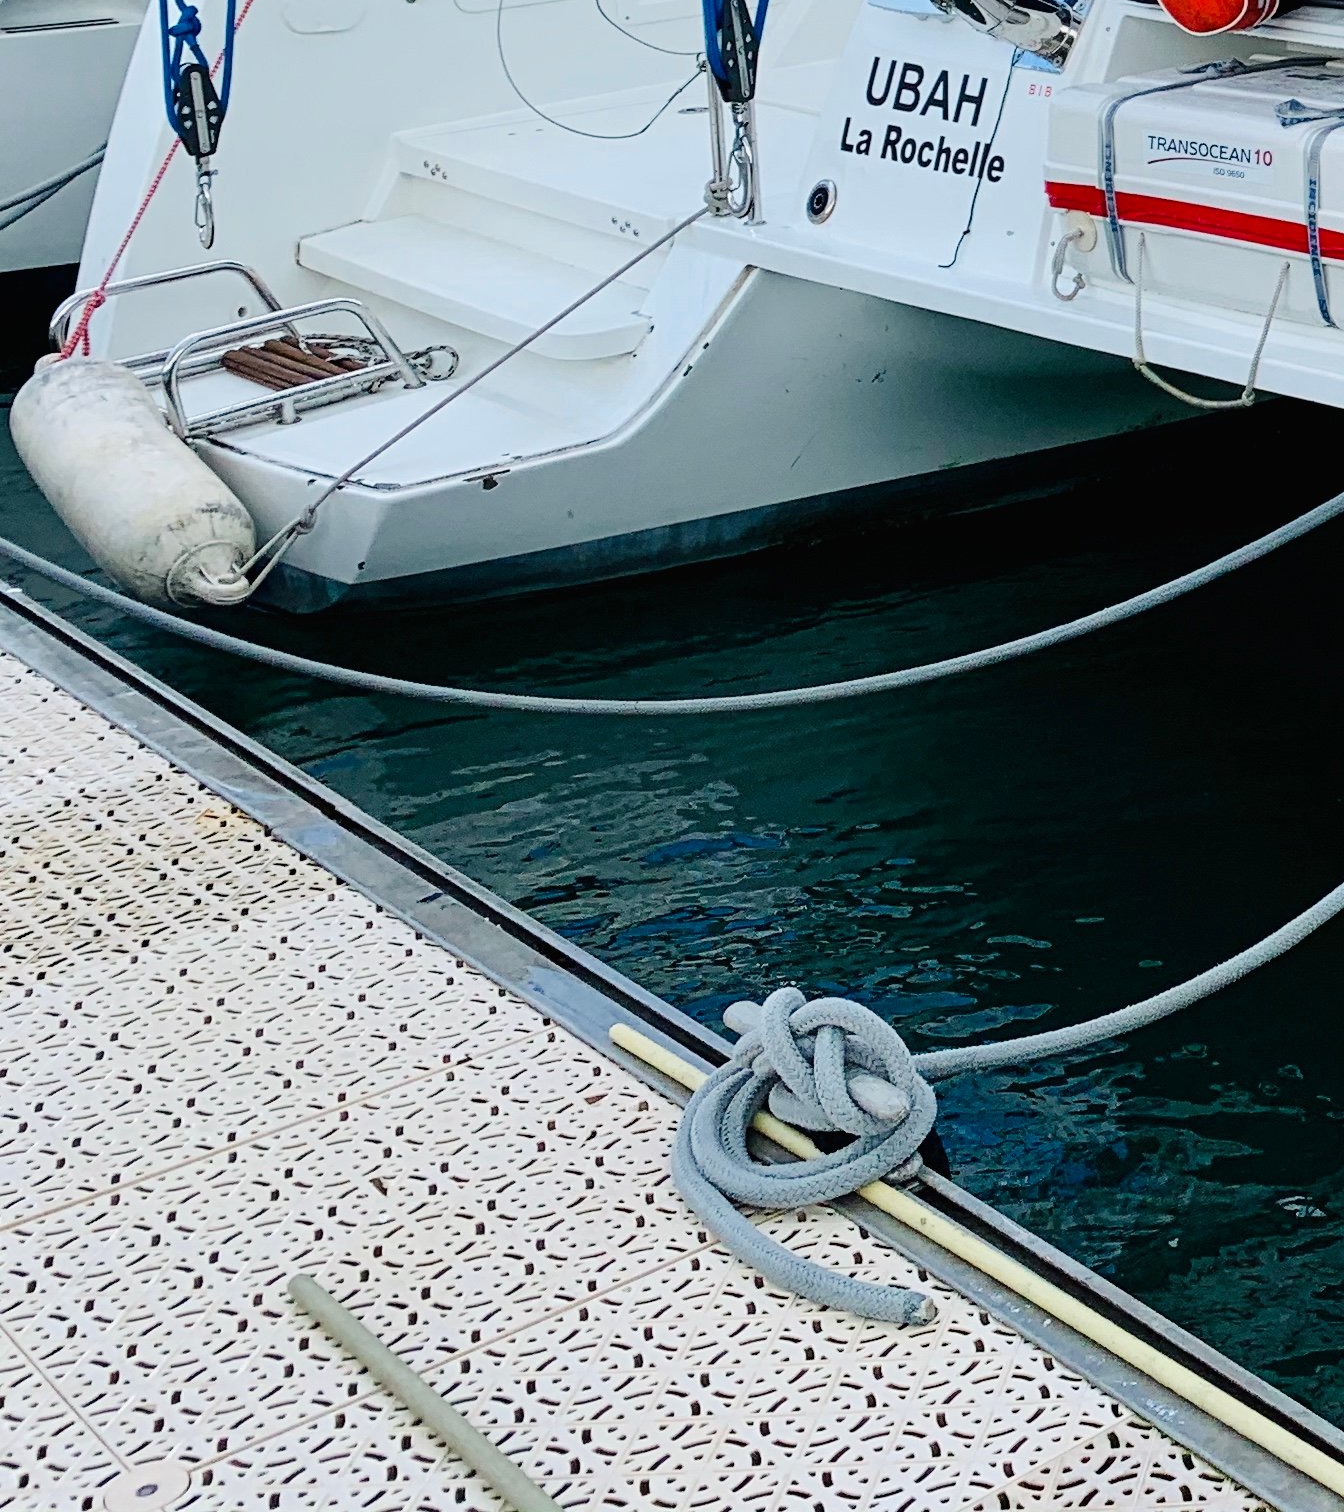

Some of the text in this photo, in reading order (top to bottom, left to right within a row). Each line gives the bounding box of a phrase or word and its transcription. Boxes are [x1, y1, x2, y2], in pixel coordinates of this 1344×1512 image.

[866, 56, 988, 127] UBAH
[840, 117, 1005, 183] La Rochelle
[1147, 135, 1273, 167] TRANSOCEAN 10
